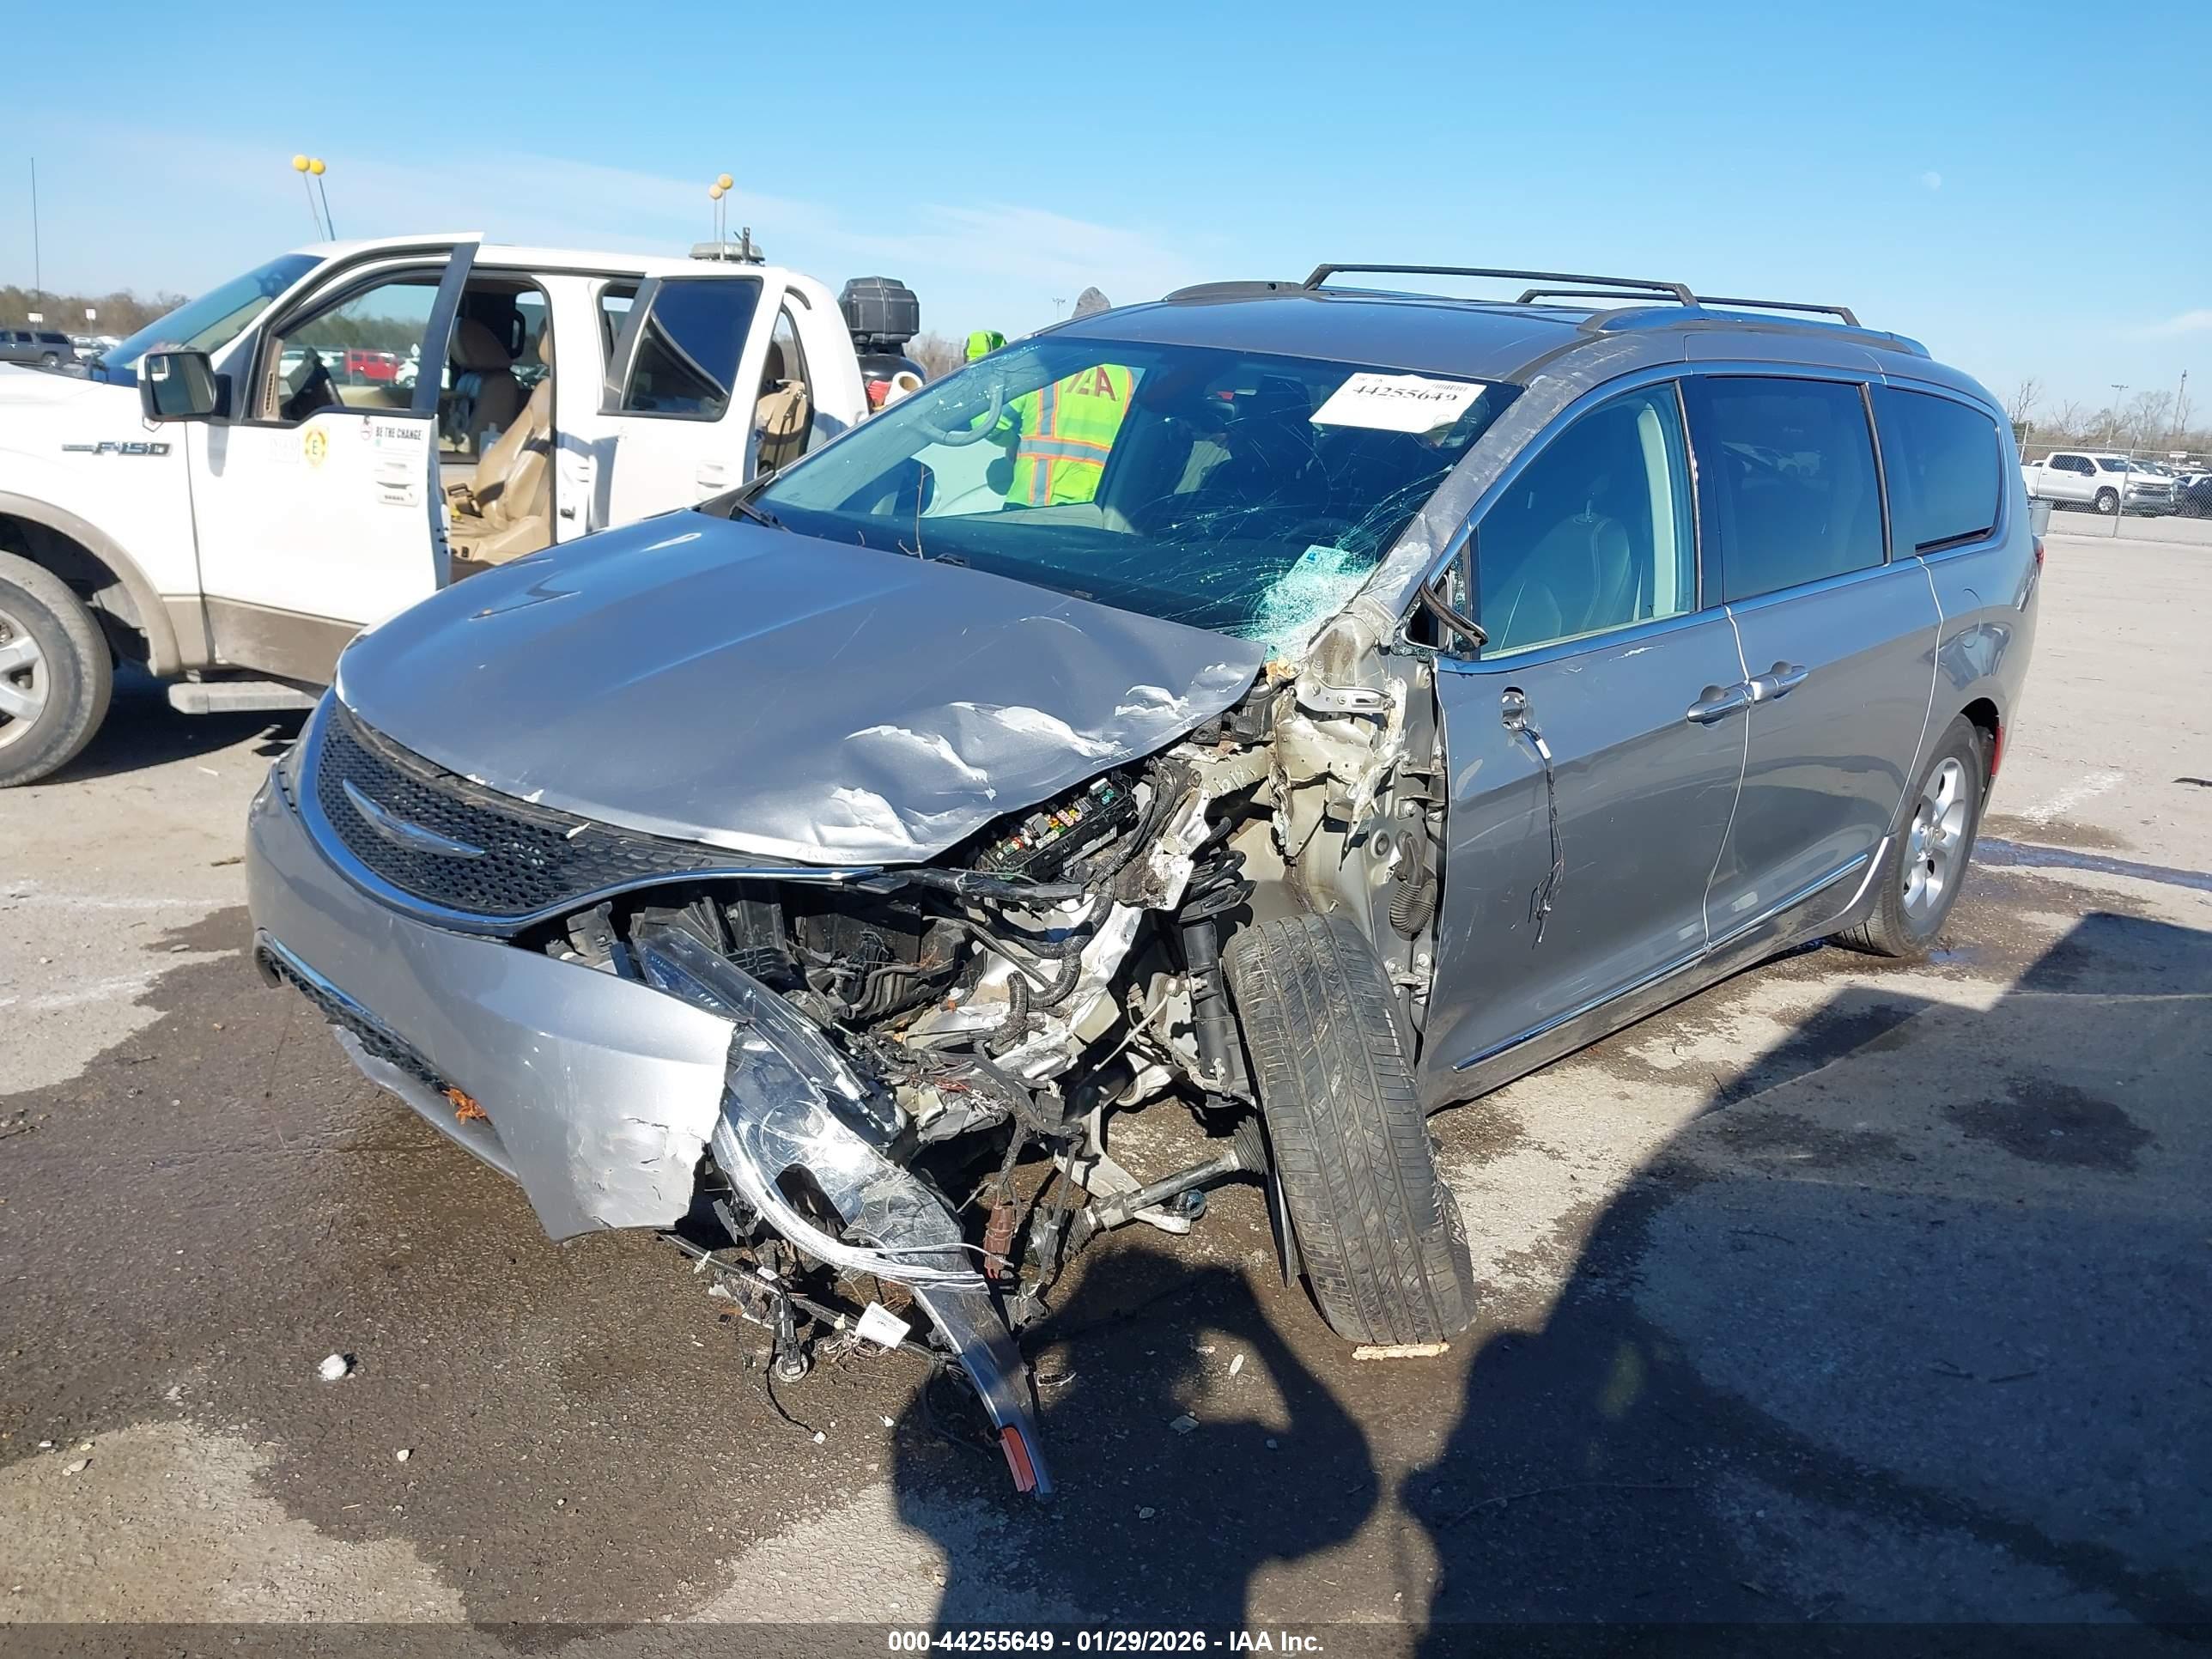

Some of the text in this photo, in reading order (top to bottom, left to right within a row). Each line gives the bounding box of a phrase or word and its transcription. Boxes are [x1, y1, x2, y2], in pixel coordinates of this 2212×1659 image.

[1352, 384, 1459, 402] 44255649
[376, 426, 422, 440] BE THE CHANGE
